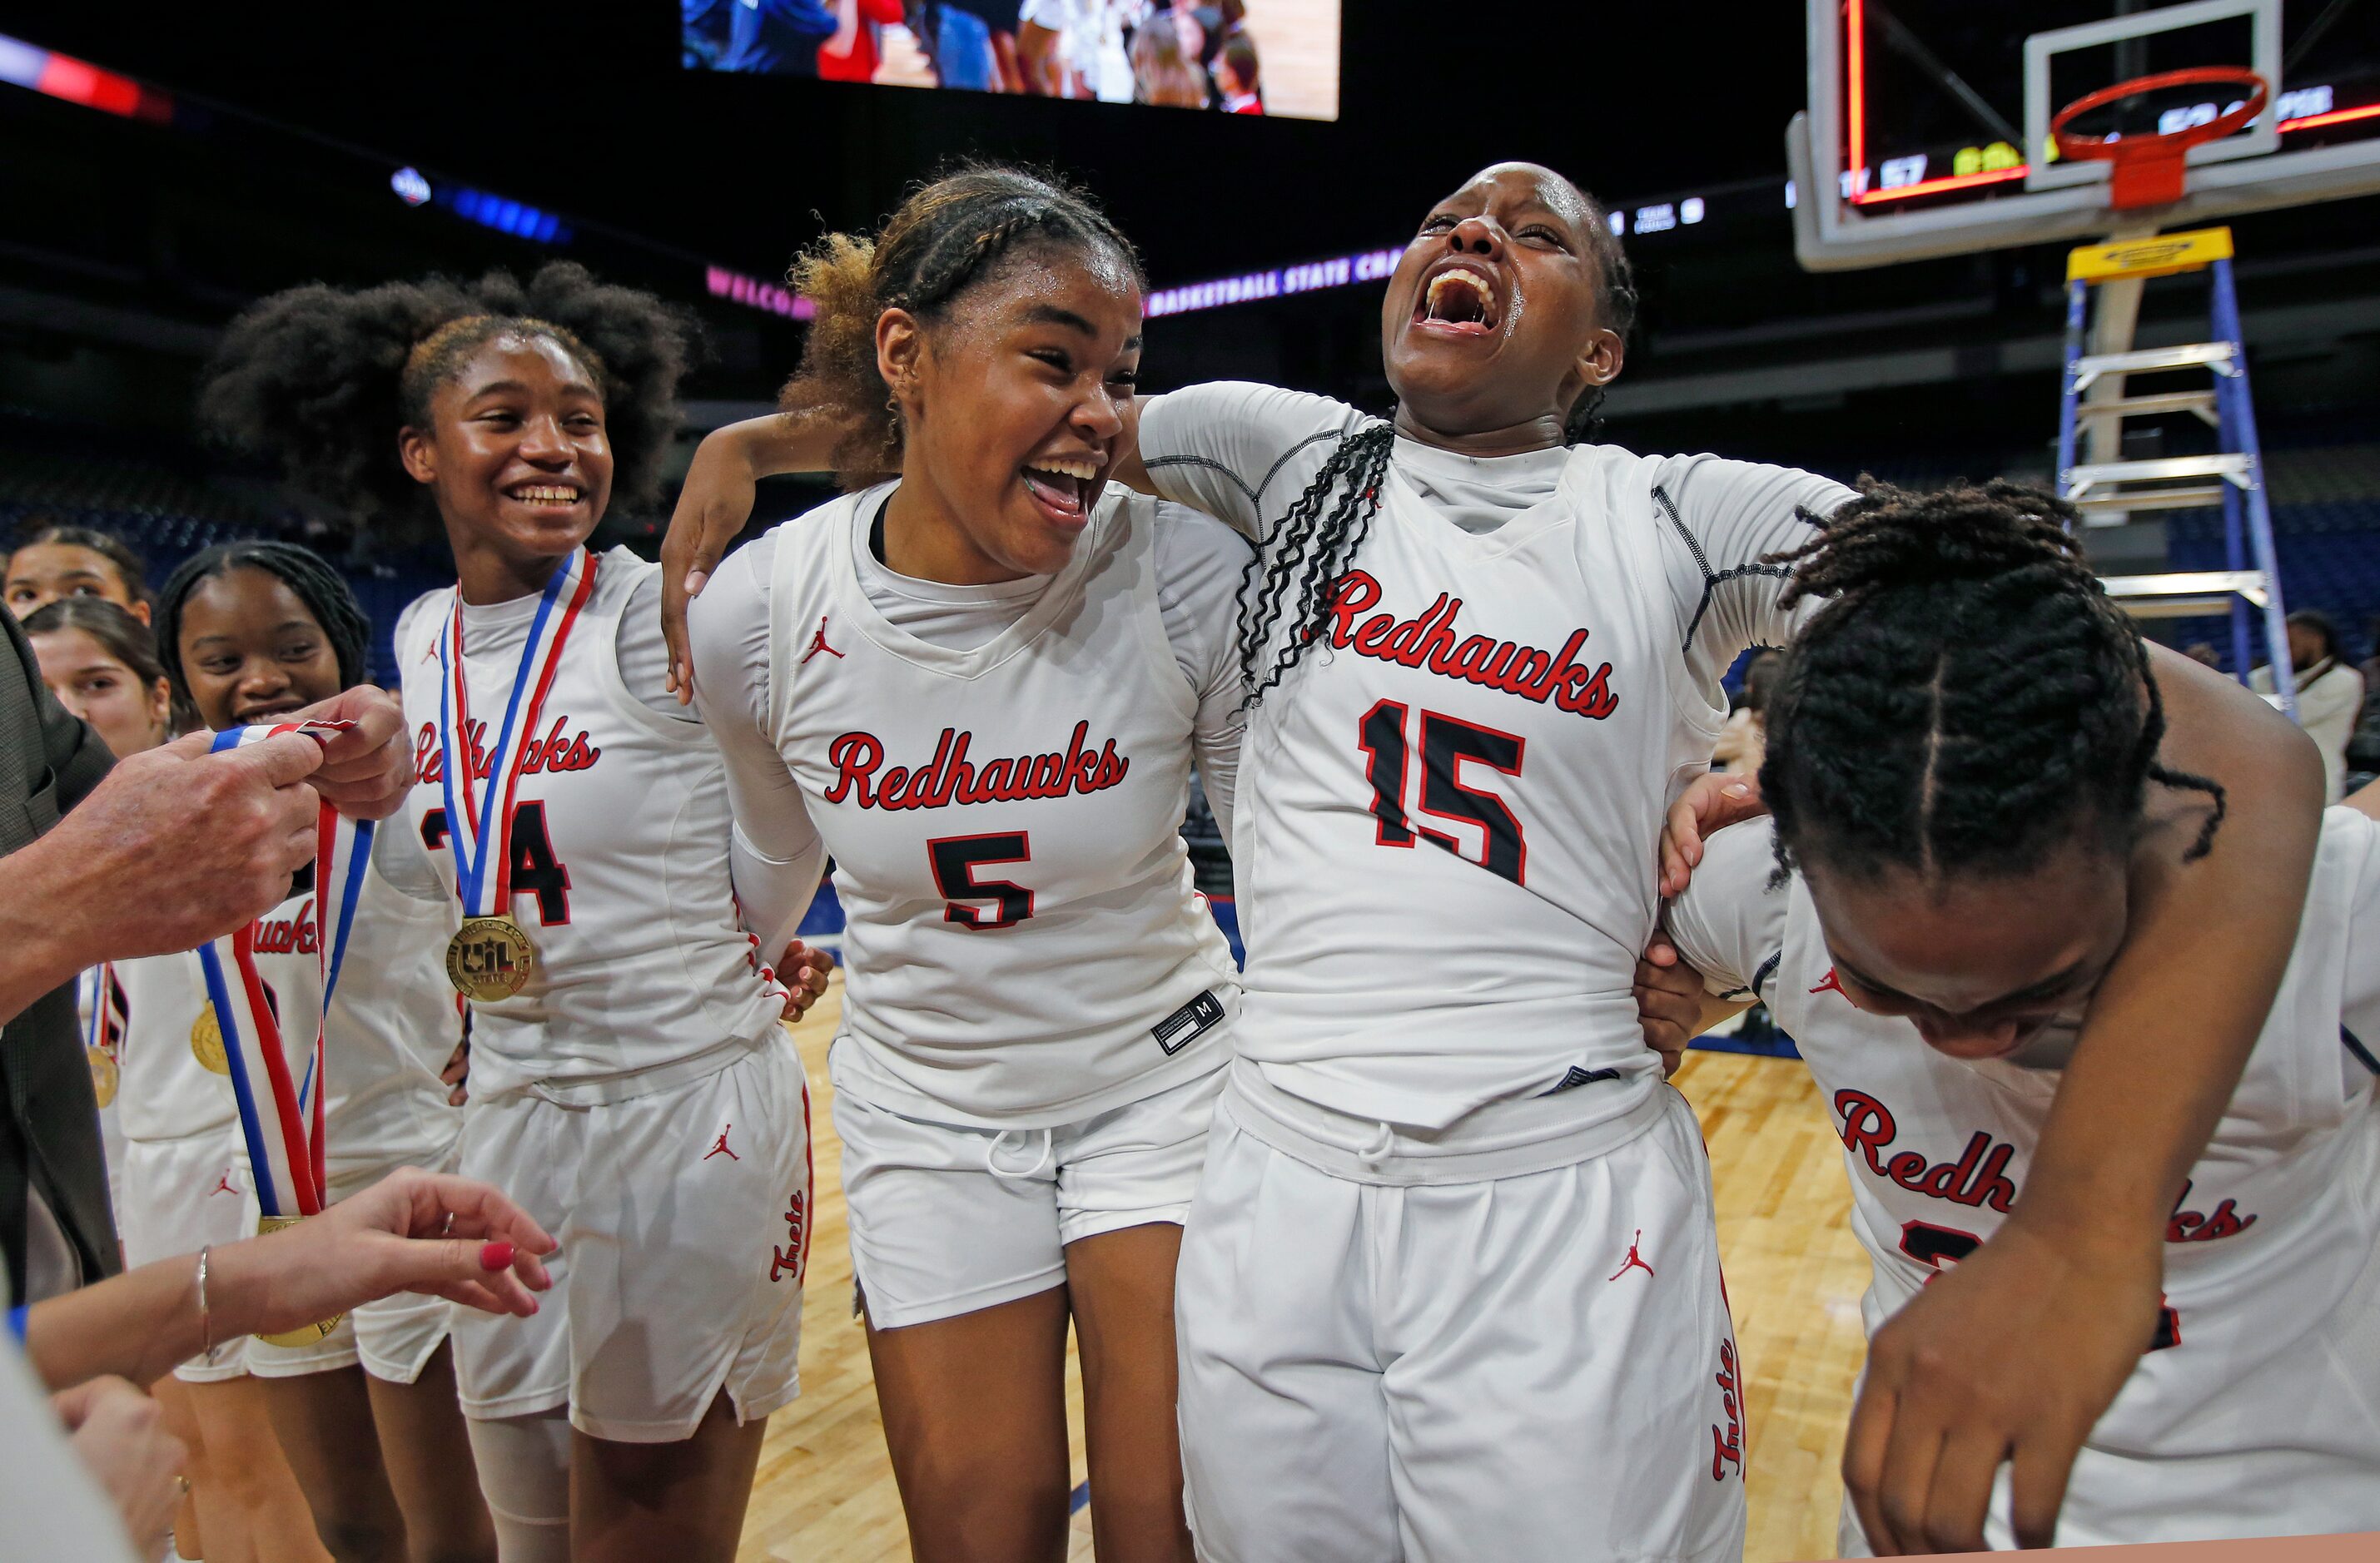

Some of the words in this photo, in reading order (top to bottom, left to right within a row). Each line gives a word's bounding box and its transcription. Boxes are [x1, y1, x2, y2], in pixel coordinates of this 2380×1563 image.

[706, 265, 817, 320] WELCOM
[1147, 270, 1278, 318] BASKETBALL
[1282, 256, 1351, 295] STATE
[1354, 247, 1407, 282] CHA
[1301, 569, 1619, 720] Redhawks
[414, 716, 601, 785] Rehks
[824, 720, 1130, 811] Redhawks
[1358, 698, 1528, 886] 15
[927, 831, 1035, 930] 5
[472, 972, 509, 985] STATE
[1196, 1001, 1212, 1017] M
[1834, 1089, 2258, 1243] Redhks
